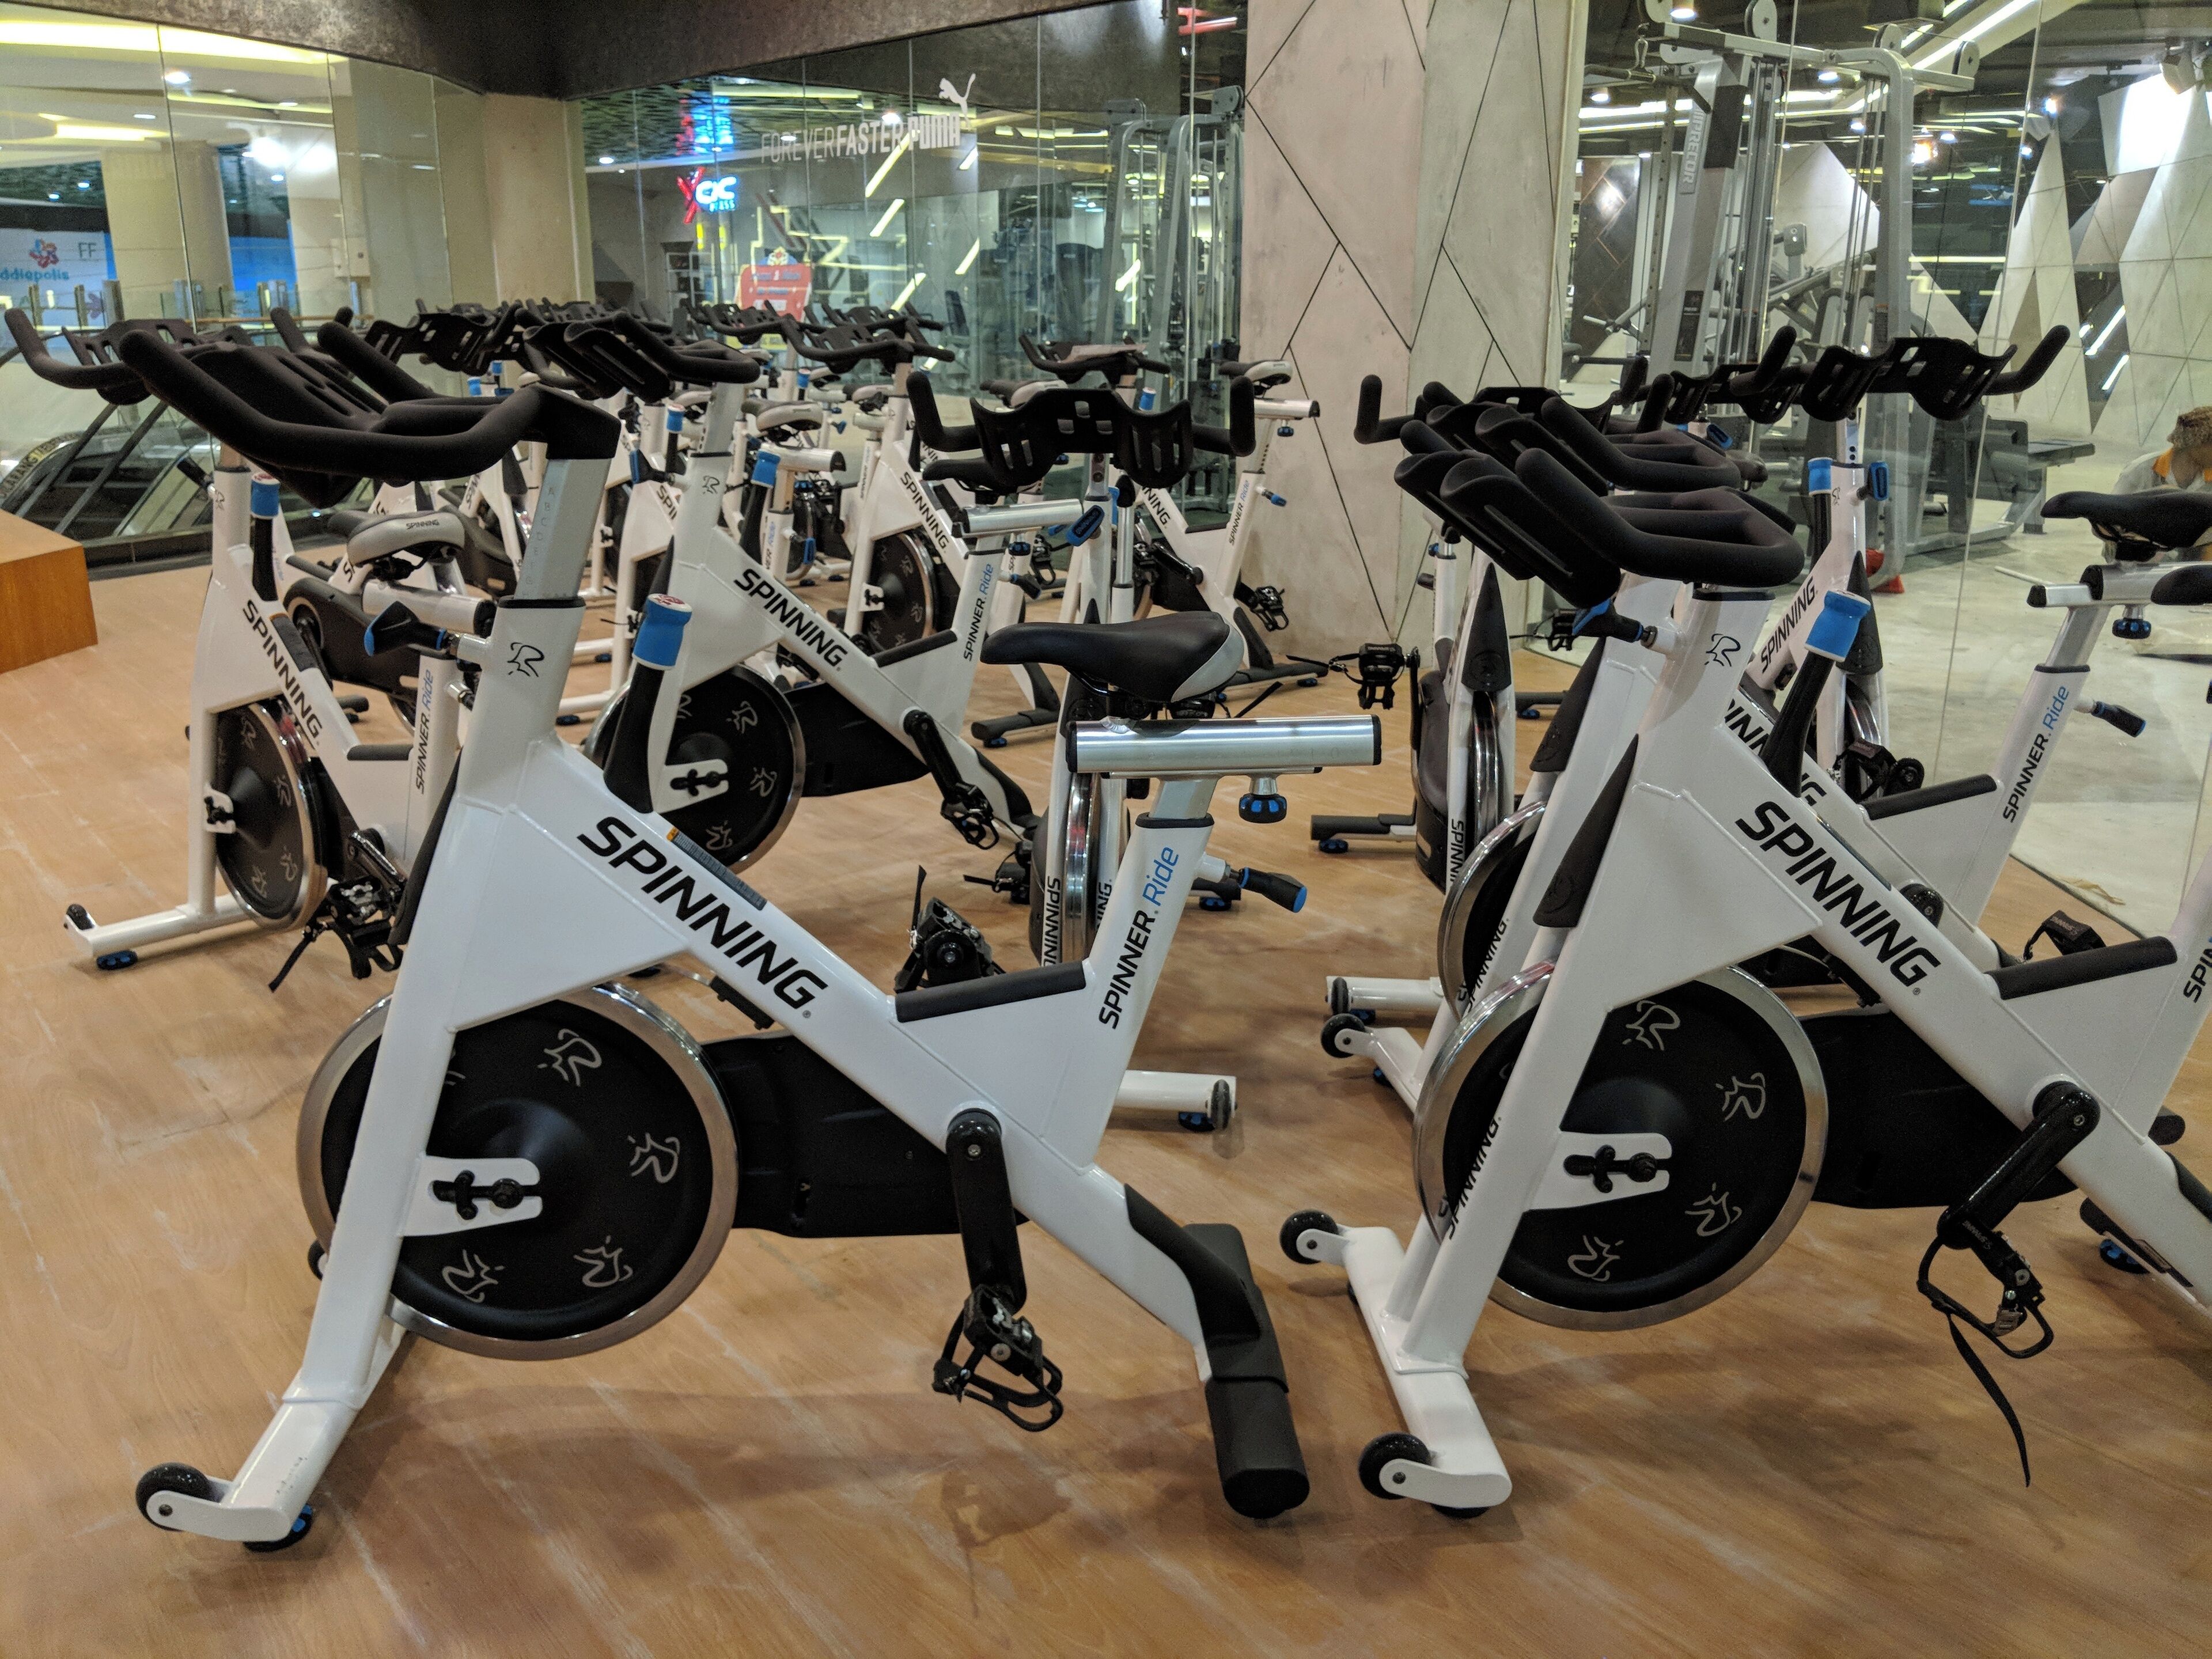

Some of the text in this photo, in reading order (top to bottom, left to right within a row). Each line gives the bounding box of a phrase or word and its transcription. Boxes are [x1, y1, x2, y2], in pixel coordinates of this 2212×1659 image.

[908, 112, 960, 151] PUMA
[406, 520, 440, 530] SPINNING
[900, 471, 949, 550] SPINNING
[1229, 480, 1251, 546] SPINNER Ride
[733, 568, 849, 667] SPINNING
[963, 563, 994, 662] SPINNER Ride
[1761, 575, 1815, 674] SPINNING
[243, 599, 323, 738] SPINNING
[415, 669, 434, 796] SPINNER Ride
[2002, 685, 2070, 823] SPINNER Ride
[577, 816, 828, 1010] SPINNING
[1099, 846, 1180, 1030] SPINNER Ride
[1734, 801, 1942, 987] SPINNING
